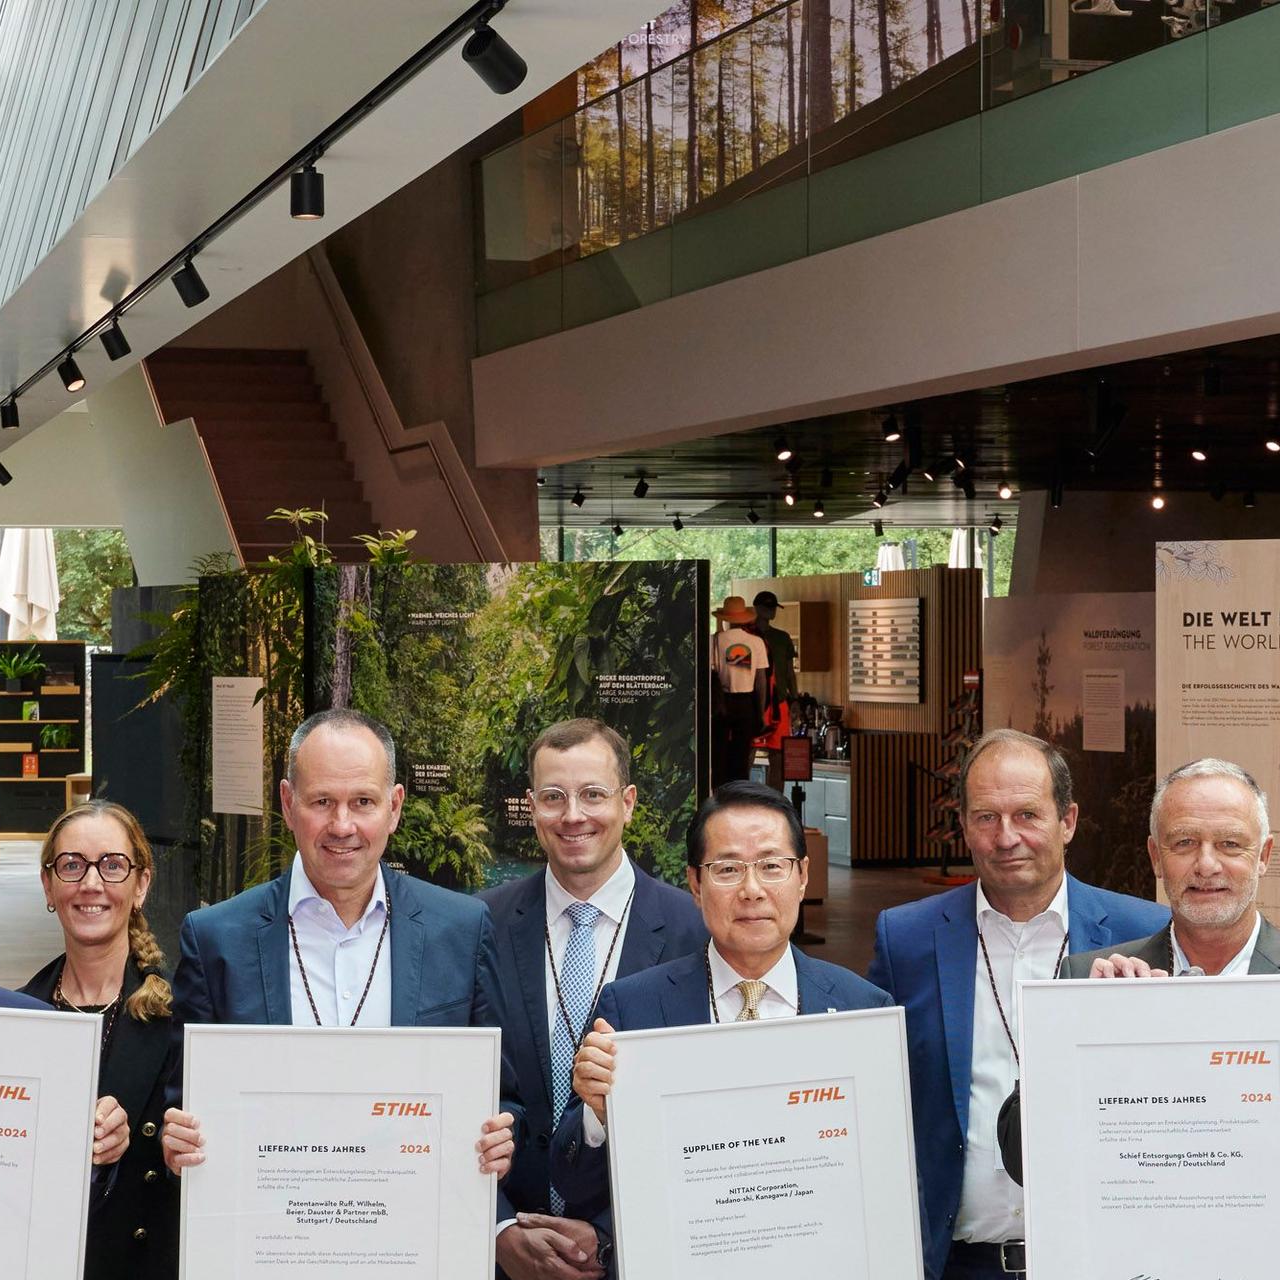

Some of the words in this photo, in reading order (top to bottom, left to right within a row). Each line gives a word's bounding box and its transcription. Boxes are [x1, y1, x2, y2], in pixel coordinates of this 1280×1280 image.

[1183, 612, 1213, 627] DIE
[1221, 612, 1270, 626] WELT
[1183, 635, 1216, 650] THE
[1210, 1051, 1271, 1065] STIHL
[787, 1087, 845, 1105] STIHL
[1172, 1096, 1207, 1104] JAHRES
[1241, 1093, 1272, 1102] 2024
[372, 1103, 432, 1116] STIHL
[683, 1143, 725, 1154] SUPPLIER
[743, 1139, 760, 1147] THE
[762, 1137, 786, 1145] YEAR
[819, 1128, 847, 1139] 2024
[400, 1145, 431, 1153] 2024
[1142, 1152, 1185, 1160] Entsorgungs
[729, 1187, 755, 1195] NITTAN
[757, 1182, 798, 1193] Corporation,
[756, 1191, 788, 1201] Kanagawa
[795, 1189, 814, 1198] Japan
[339, 1200, 355, 1208] Ruff,
